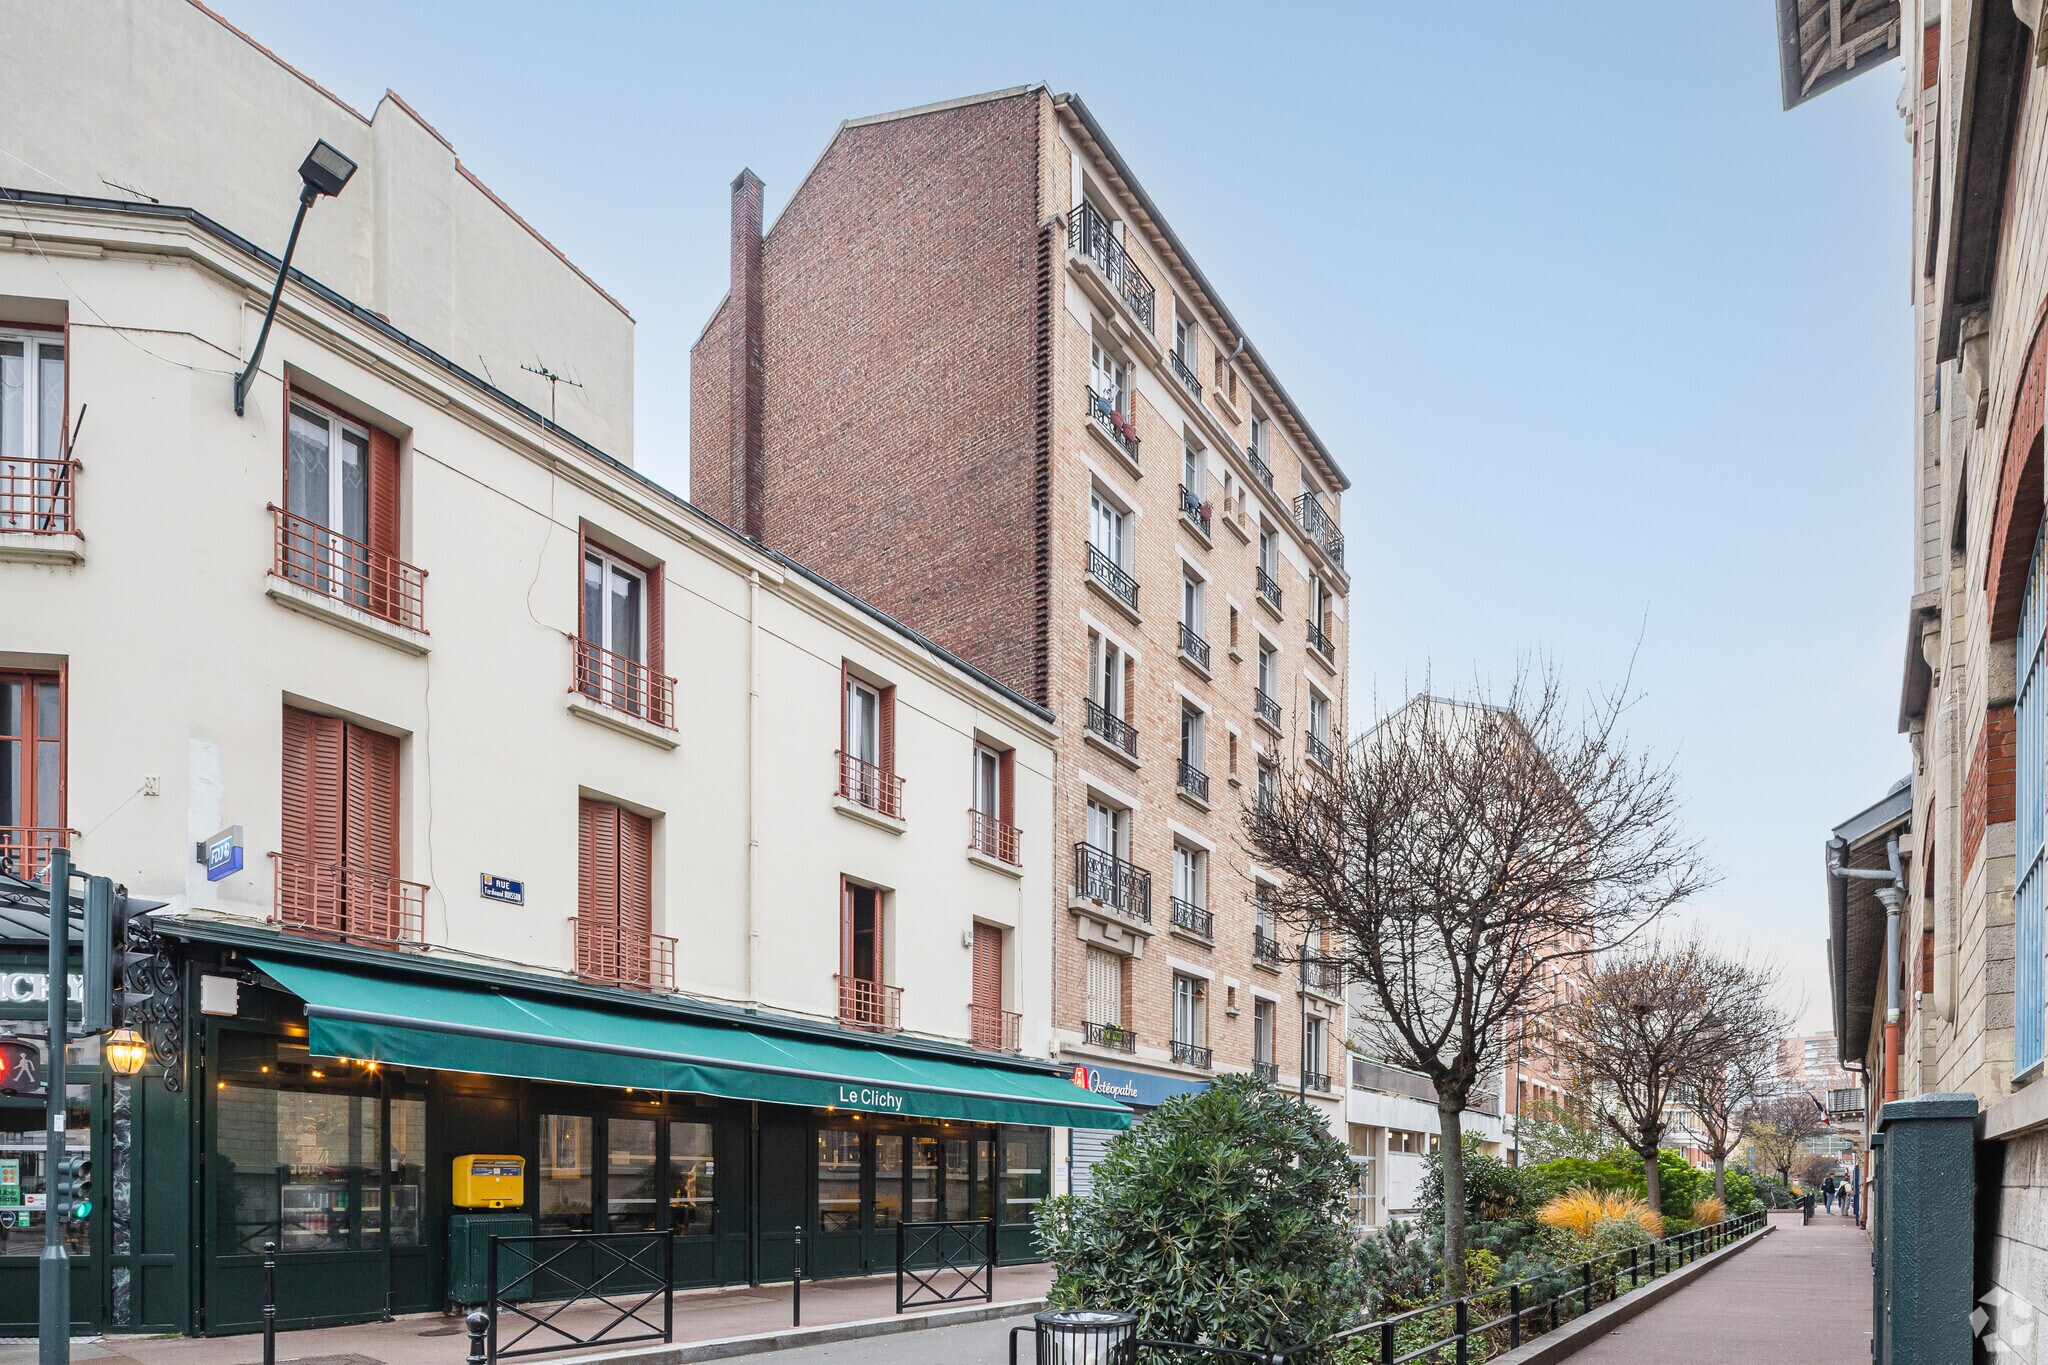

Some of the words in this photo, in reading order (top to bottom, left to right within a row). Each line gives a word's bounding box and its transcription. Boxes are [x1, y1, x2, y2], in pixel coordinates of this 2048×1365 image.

[495, 880, 510, 890] RUE
[1089, 1069, 1138, 1099] Ostéopathe
[840, 1085, 858, 1103] Le
[861, 1089, 903, 1111] Clichy
